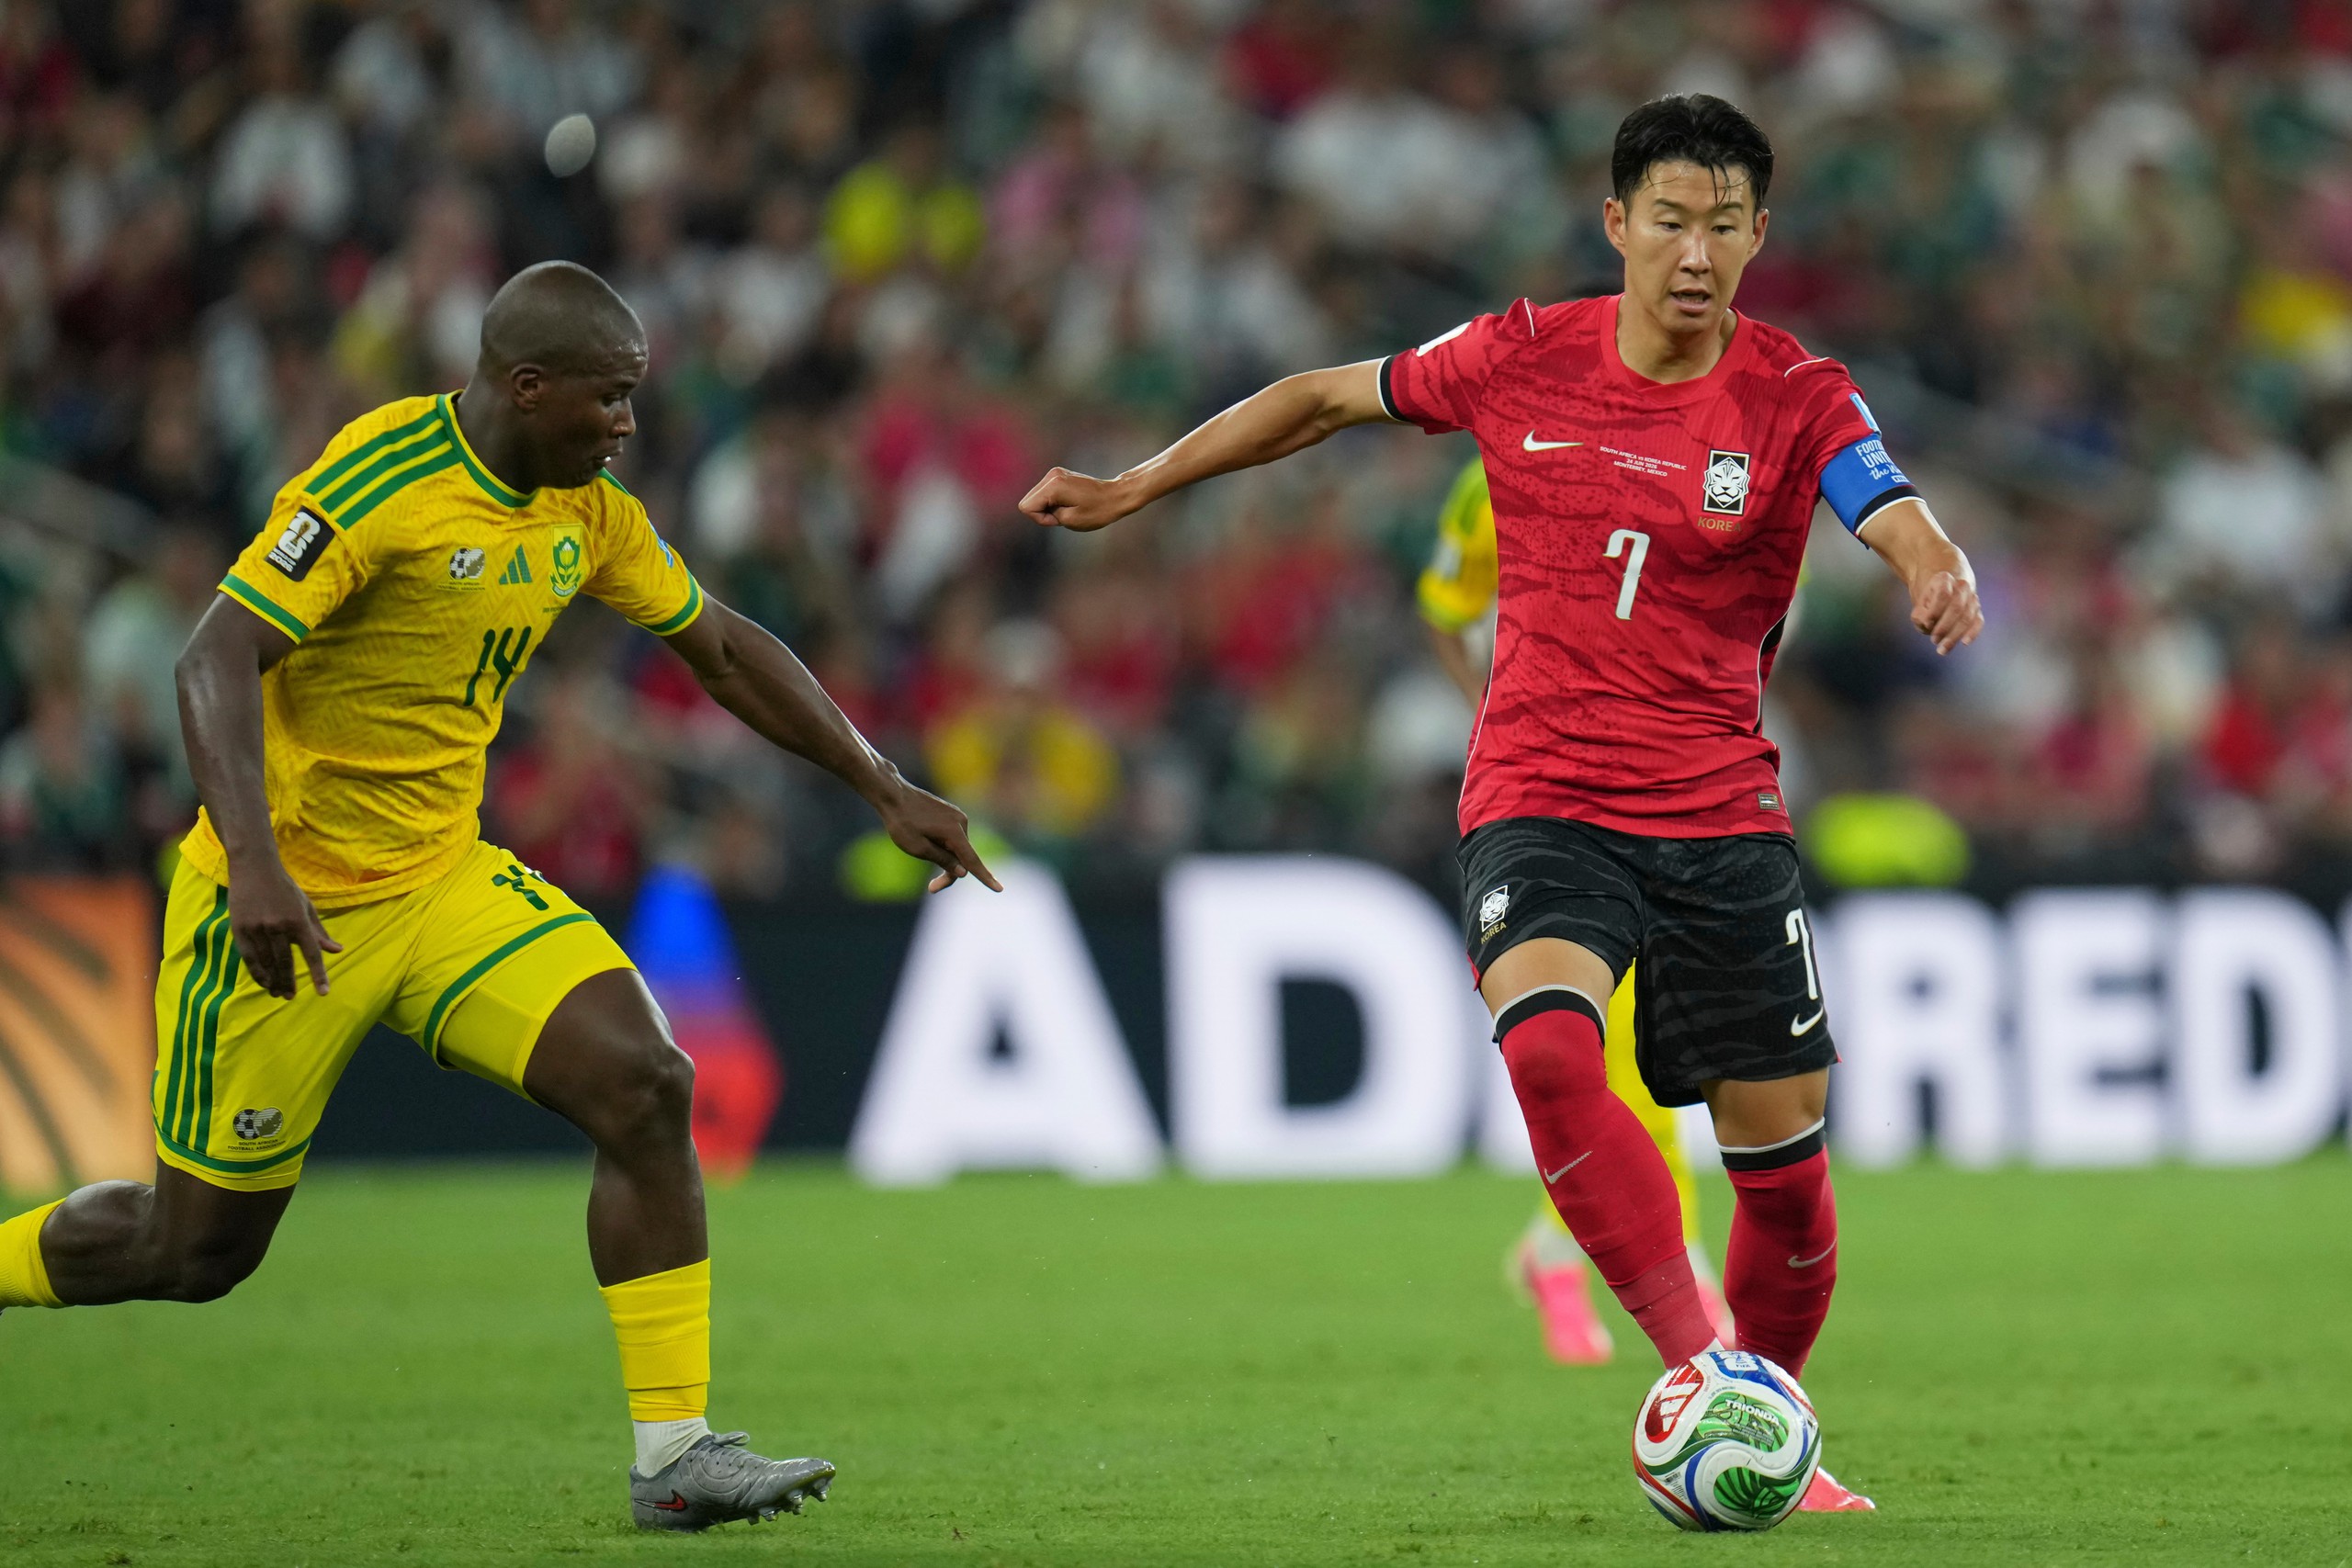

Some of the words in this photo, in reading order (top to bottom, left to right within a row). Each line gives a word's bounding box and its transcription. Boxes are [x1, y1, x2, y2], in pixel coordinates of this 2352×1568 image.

[1600, 446, 1619, 455] SOUTH
[1618, 451, 1637, 459] AFRICA
[1645, 457, 1661, 465] KOREA
[1661, 460, 1687, 470] REPUBLIC
[1646, 468, 1668, 477] MEXICO
[1869, 467, 1890, 480] the
[1697, 515, 1743, 533] KOREA
[1602, 528, 1650, 621] 7
[462, 626, 532, 706] 14
[1480, 921, 1507, 944] KOREA
[1784, 907, 1819, 1000] 7
[1724, 1398, 1781, 1427] TRIONDA
